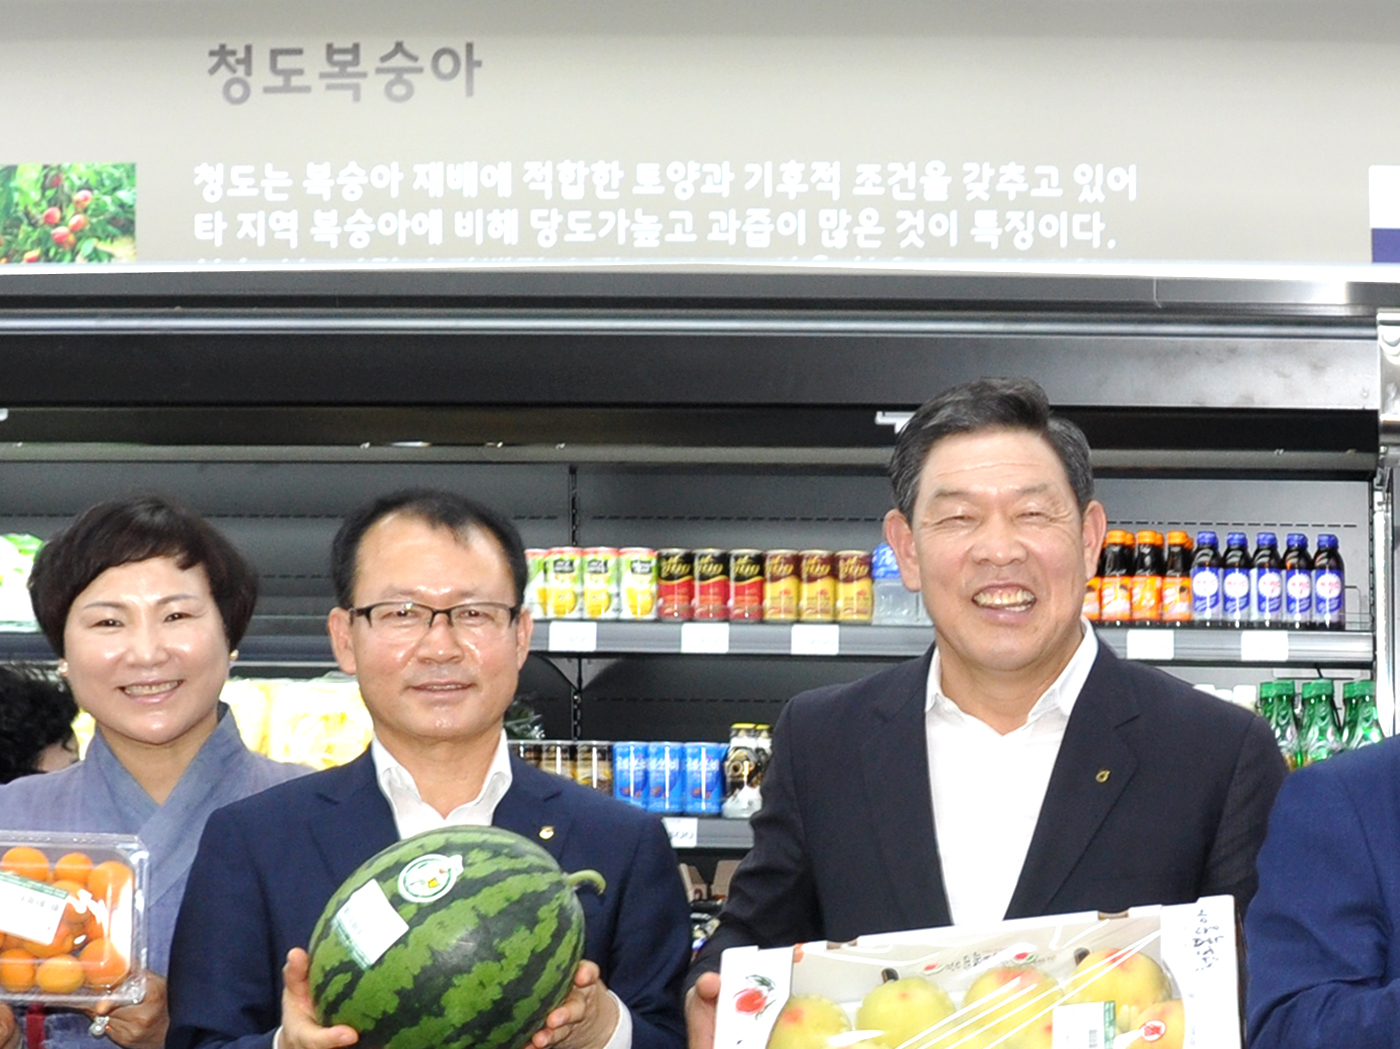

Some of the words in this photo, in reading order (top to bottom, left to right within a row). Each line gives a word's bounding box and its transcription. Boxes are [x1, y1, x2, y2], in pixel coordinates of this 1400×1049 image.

[206, 40, 483, 105] 청도복숭아
[194, 163, 293, 202] 청도는
[303, 161, 404, 201] 복숭아
[413, 161, 511, 197] 재배에
[523, 160, 624, 200] 적합한
[633, 161, 735, 199] 토양과
[745, 160, 840, 200] 기후적
[853, 160, 952, 201] 조건을
[963, 162, 1063, 201] 갖추고
[1074, 164, 1136, 203] 있어
[194, 211, 227, 247] 타
[237, 210, 298, 248] 지역
[310, 208, 442, 248] 복숭아에
[455, 209, 518, 245] 비해
[707, 208, 805, 247] 과즙이
[819, 208, 885, 248] 많은
[896, 209, 957, 248] 것이
[970, 210, 1115, 250] 특징이다.
